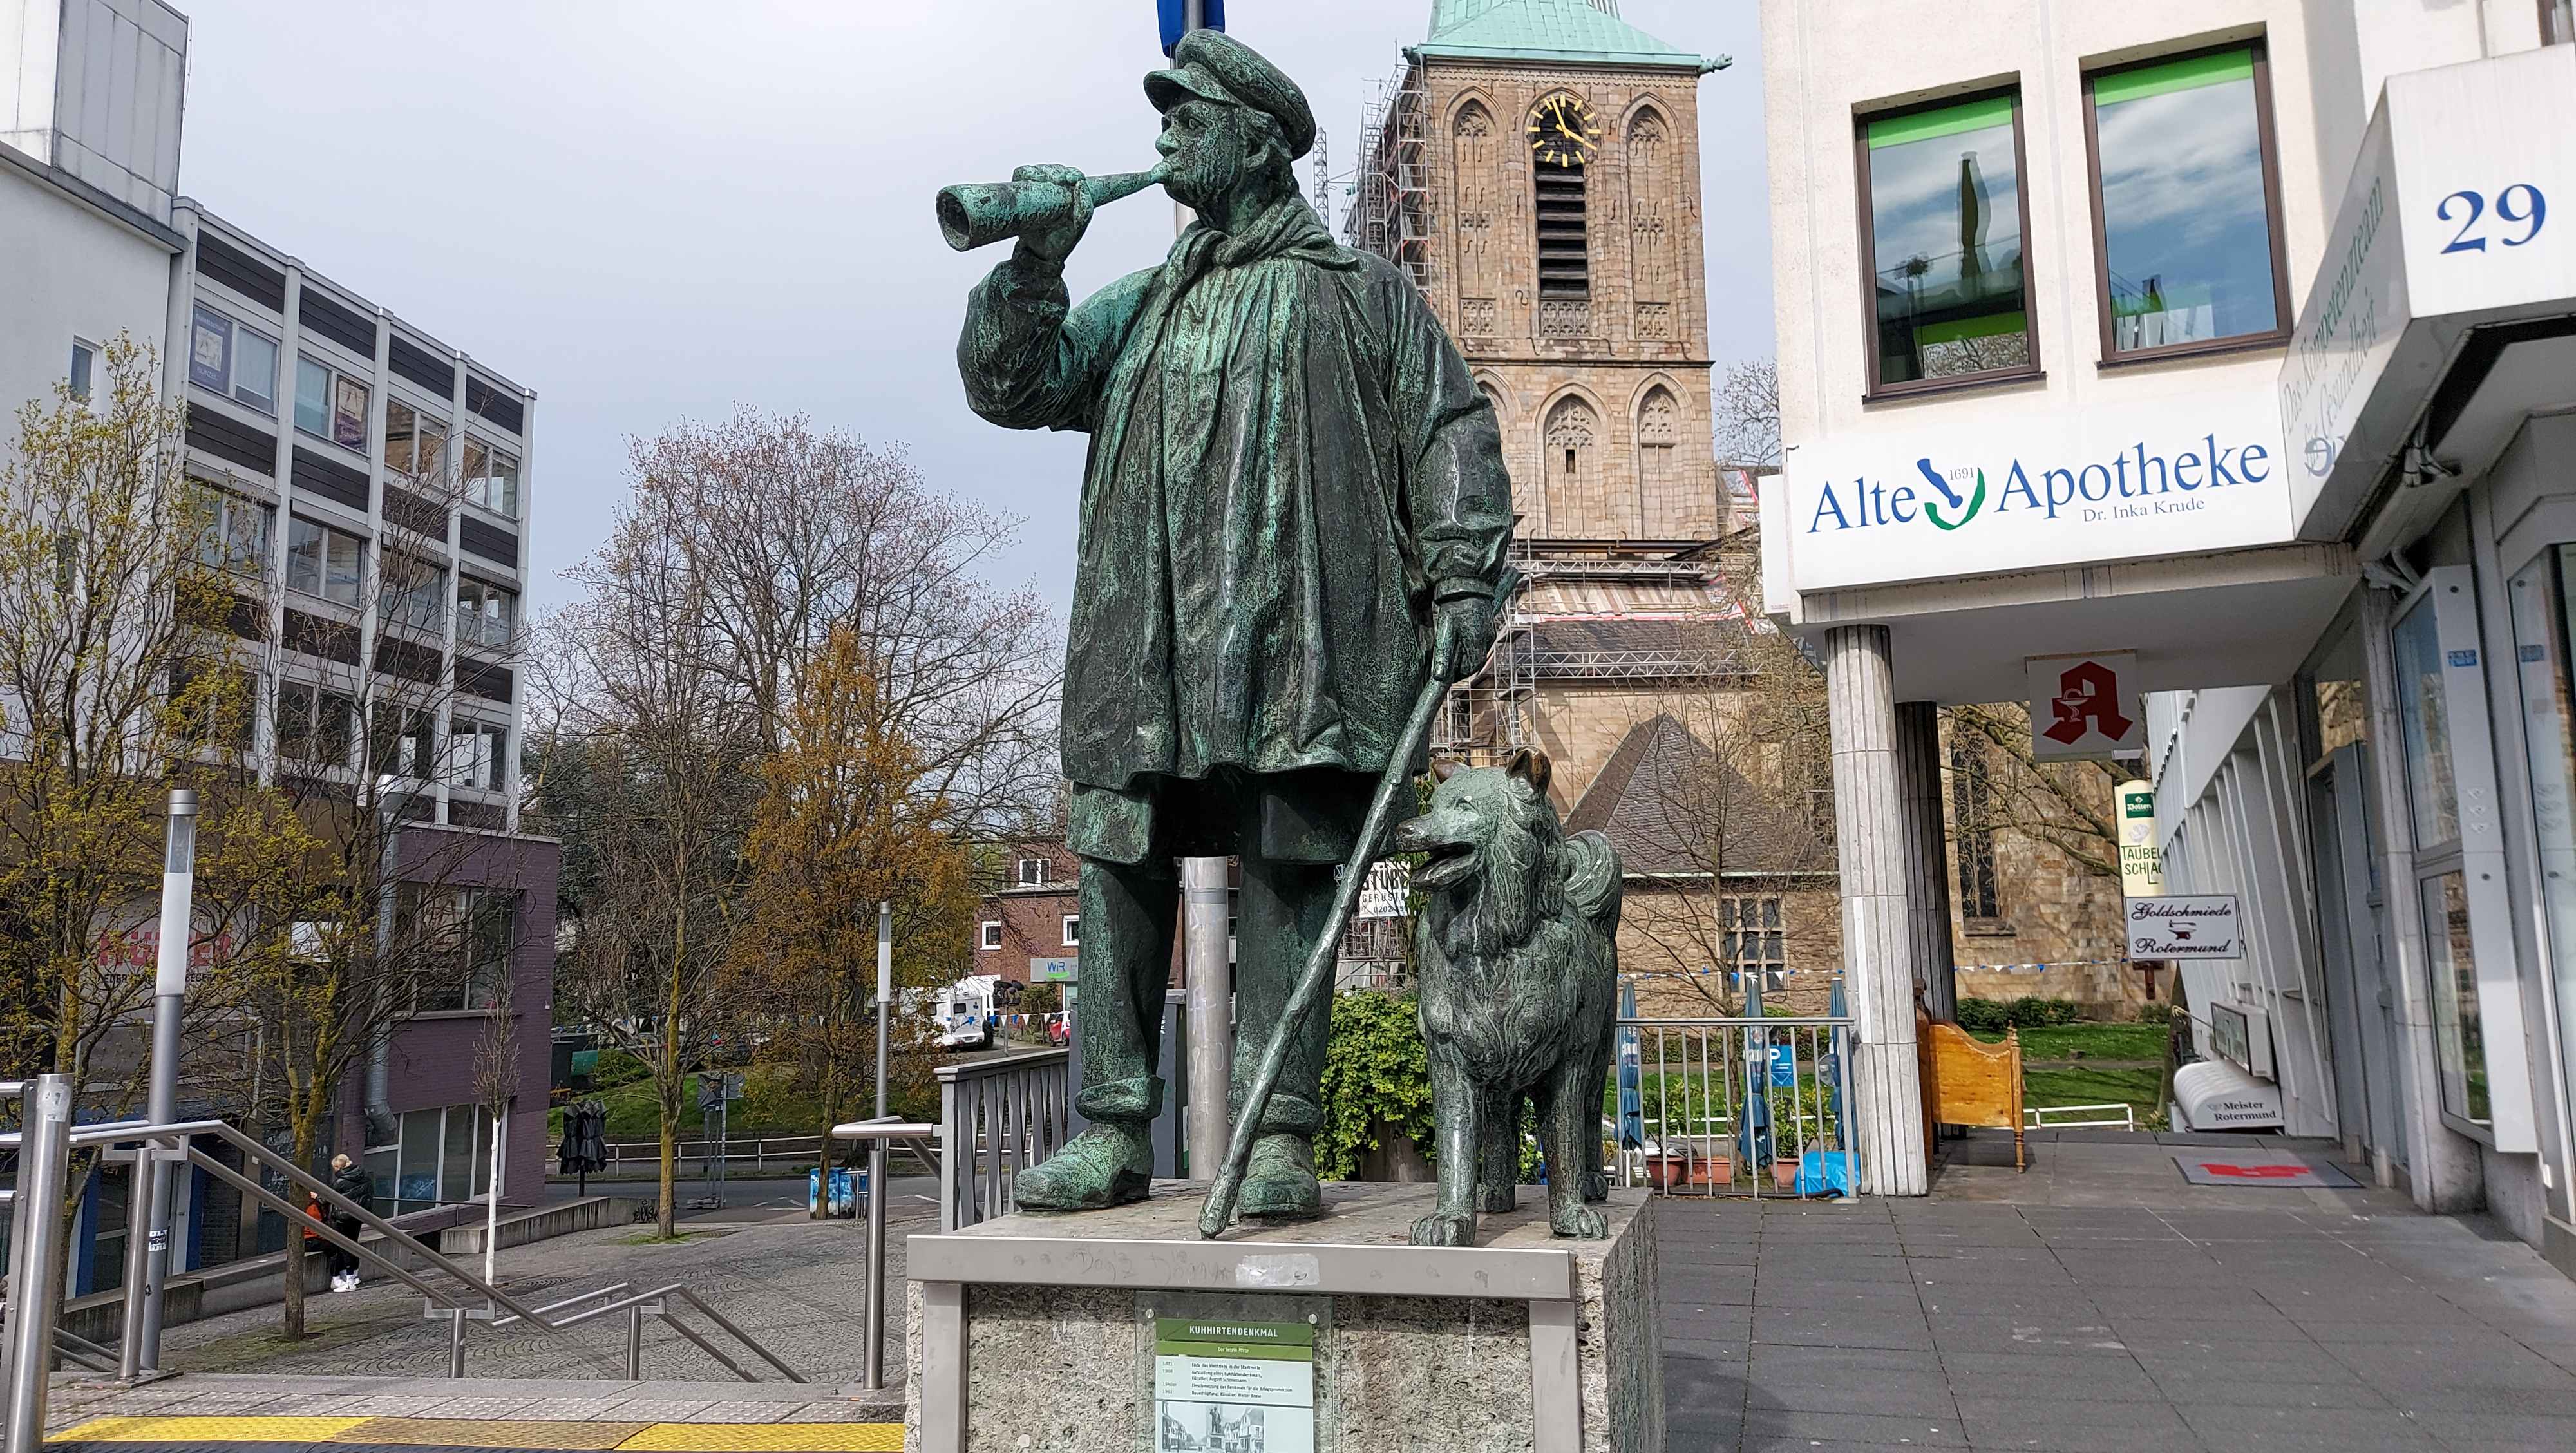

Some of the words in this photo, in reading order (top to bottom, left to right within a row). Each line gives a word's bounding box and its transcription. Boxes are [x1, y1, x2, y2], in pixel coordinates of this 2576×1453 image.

[2436, 184, 2546, 255] 29
[2282, 383, 2302, 437] Das
[2300, 176, 2384, 393] Kompetenzteam
[2320, 285, 2376, 441] Gesundheit
[1806, 477, 1917, 534] Alte
[1949, 466, 1976, 480] 1691
[1994, 433, 2270, 519] Apotheke
[2083, 508, 2107, 523] Dr.
[2113, 503, 2149, 520] Inka
[2154, 497, 2206, 515] Krude
[2131, 902, 2232, 920] Goldschmiede
[2135, 938, 2232, 954] Rotermund
[2215, 1110, 2277, 1122] Rotermund
[2224, 1101, 2264, 1111] Meister
[1189, 1325, 1278, 1338] KUHHIRTENDENKMAL
